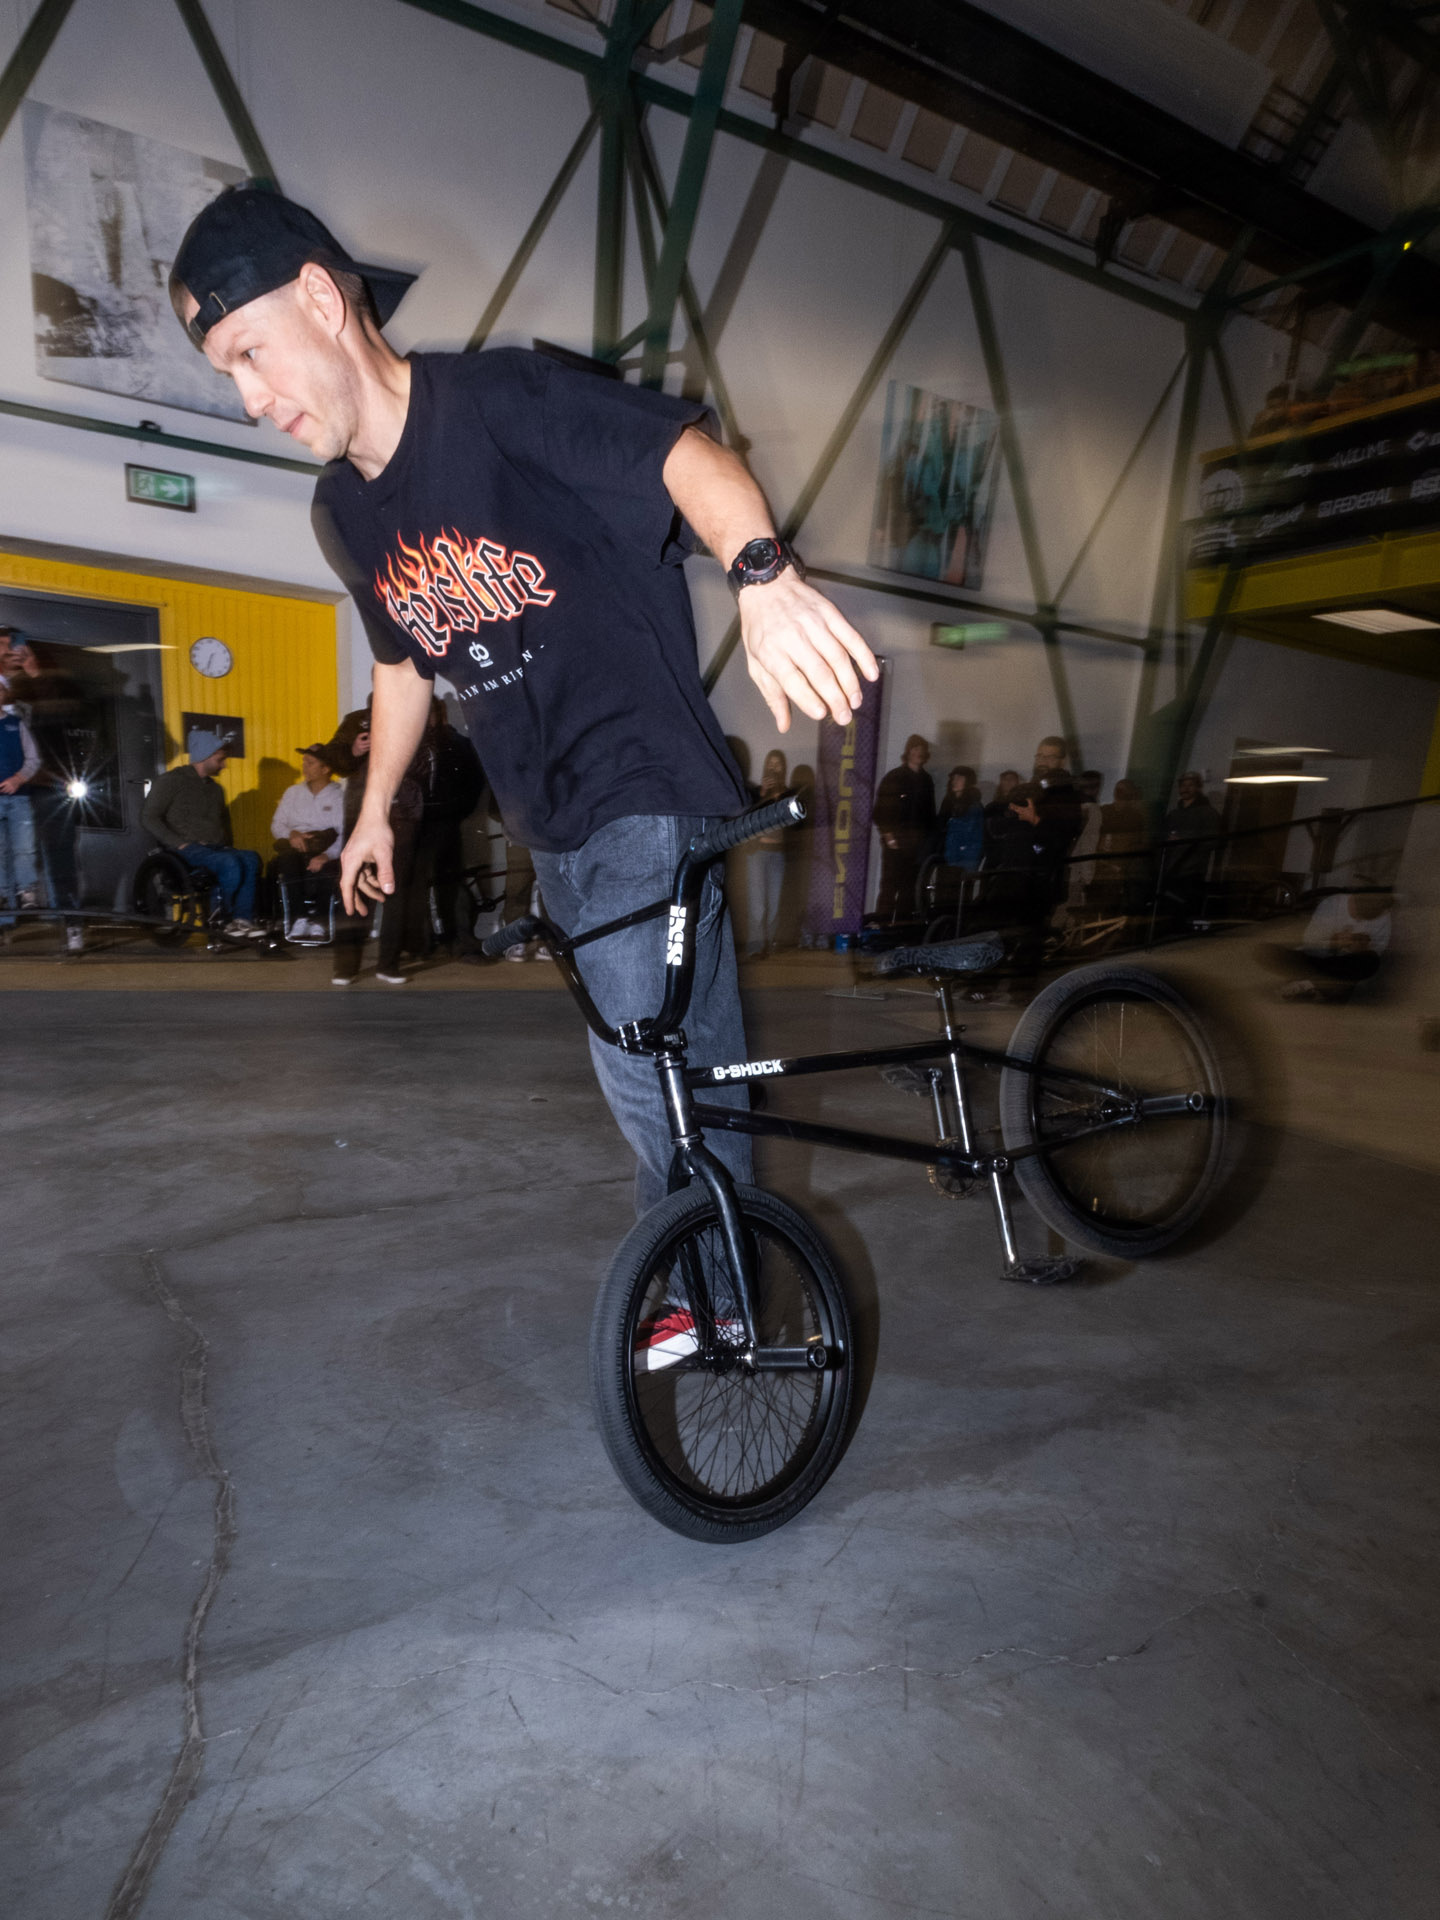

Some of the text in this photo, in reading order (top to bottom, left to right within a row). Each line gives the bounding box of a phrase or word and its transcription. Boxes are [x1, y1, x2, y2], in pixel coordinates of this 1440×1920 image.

[1333, 488, 1393, 513] FEDERAL
[483, 680, 500, 692] AM
[713, 1059, 784, 1081] G-SHOCK
